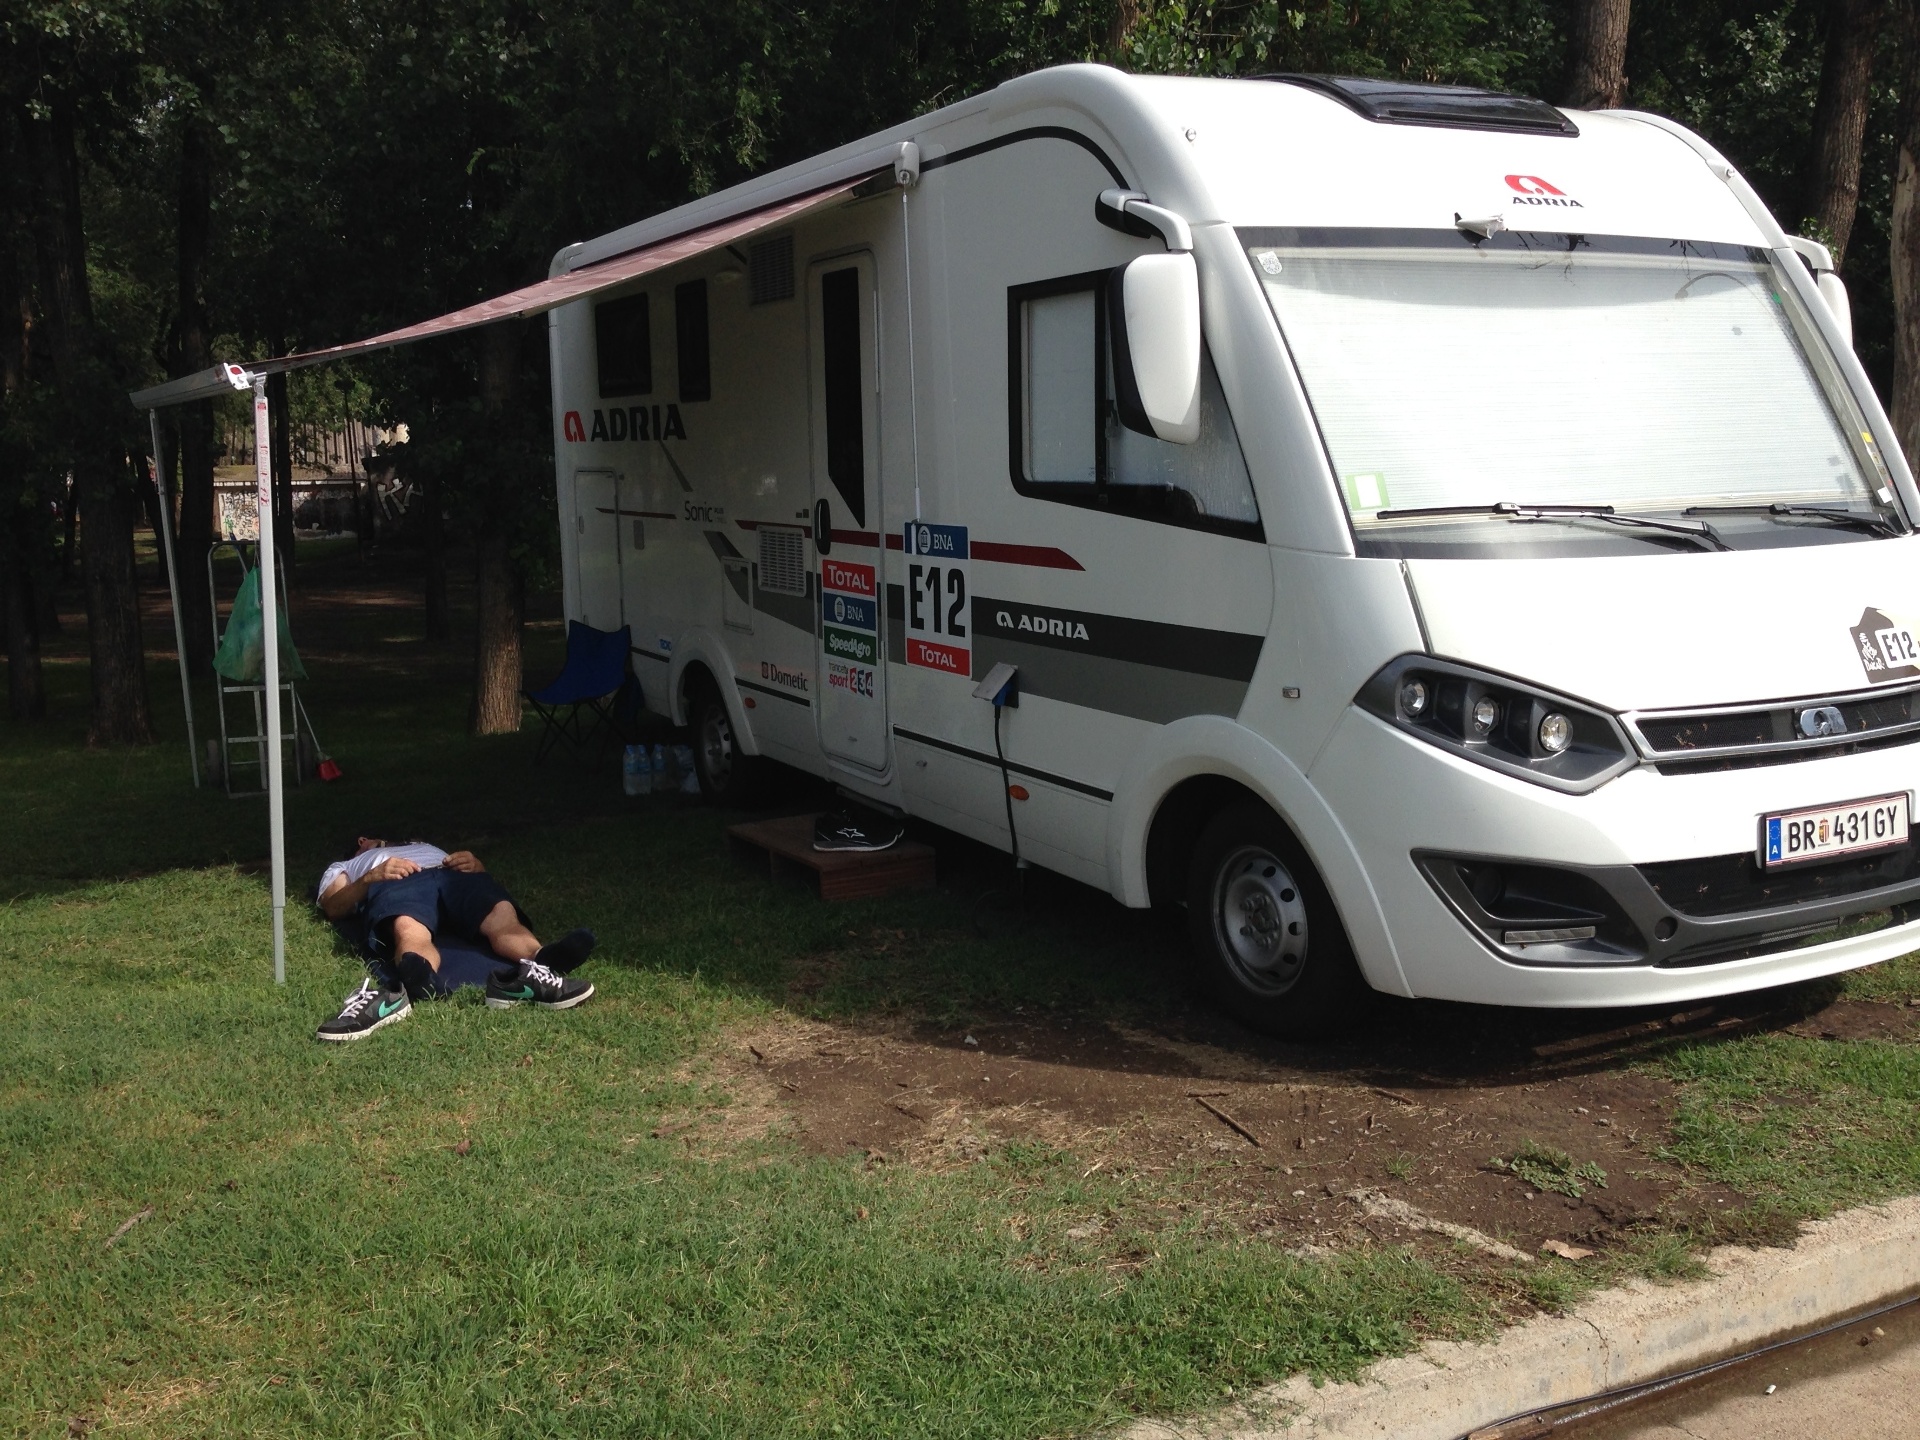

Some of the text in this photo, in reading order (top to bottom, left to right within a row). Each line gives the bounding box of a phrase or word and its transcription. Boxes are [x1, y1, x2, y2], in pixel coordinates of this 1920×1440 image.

[1513, 196, 1585, 208] ADRIA
[591, 403, 687, 442] ADRIA
[684, 501, 713, 523] Sonic
[933, 534, 954, 551] BNA
[827, 564, 870, 591] TOTAL
[909, 563, 966, 638] E12
[847, 605, 865, 622] BNA
[1017, 614, 1089, 641] ADRIA
[829, 633, 871, 659] SpeedAgro
[919, 645, 957, 668] TOTAL
[1881, 631, 1917, 661] E12
[770, 663, 809, 692] Dometic
[829, 674, 849, 688] sport
[1771, 845, 1779, 855] A
